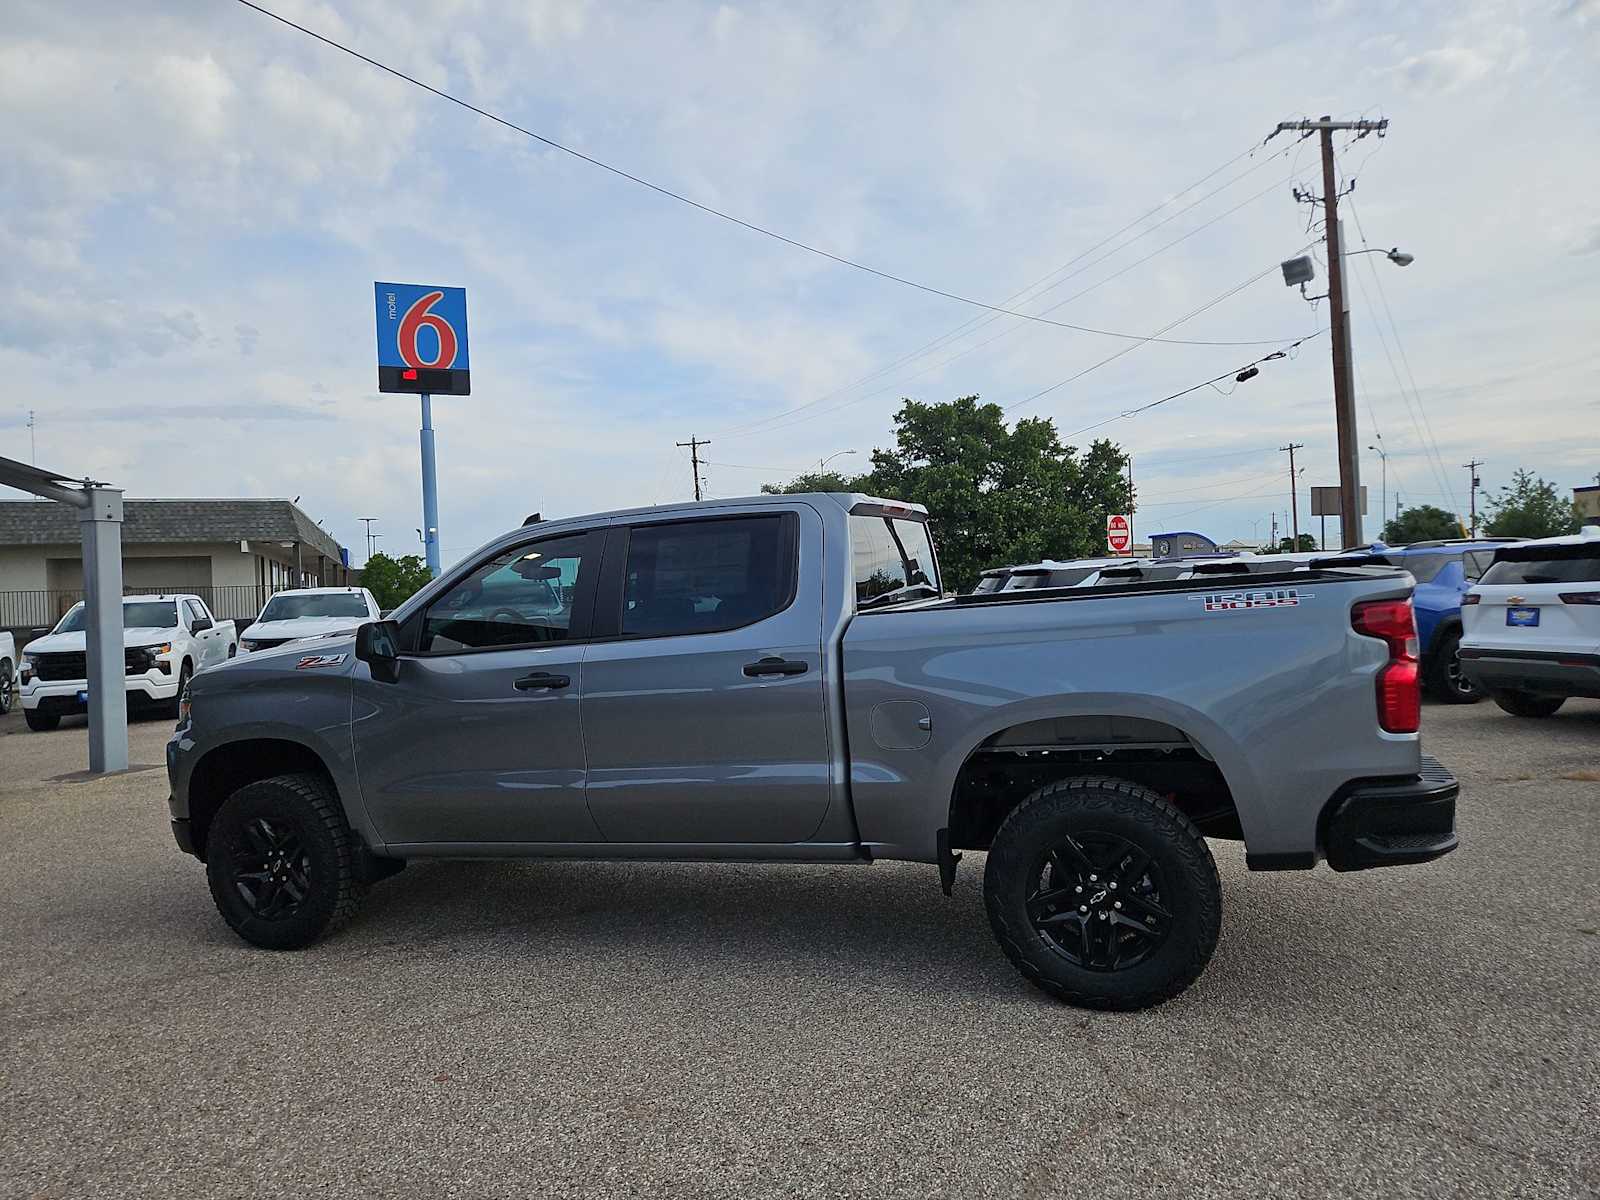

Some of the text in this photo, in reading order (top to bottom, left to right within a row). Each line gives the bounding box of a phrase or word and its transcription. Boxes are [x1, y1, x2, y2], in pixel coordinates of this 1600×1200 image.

[386, 292, 396, 319] motel
[397, 291, 458, 369] 6
[1112, 537, 1126, 545] ENTER
[1190, 589, 1313, 604] TRAIL
[1205, 599, 1300, 612] BOSS
[296, 653, 349, 670] Z71
